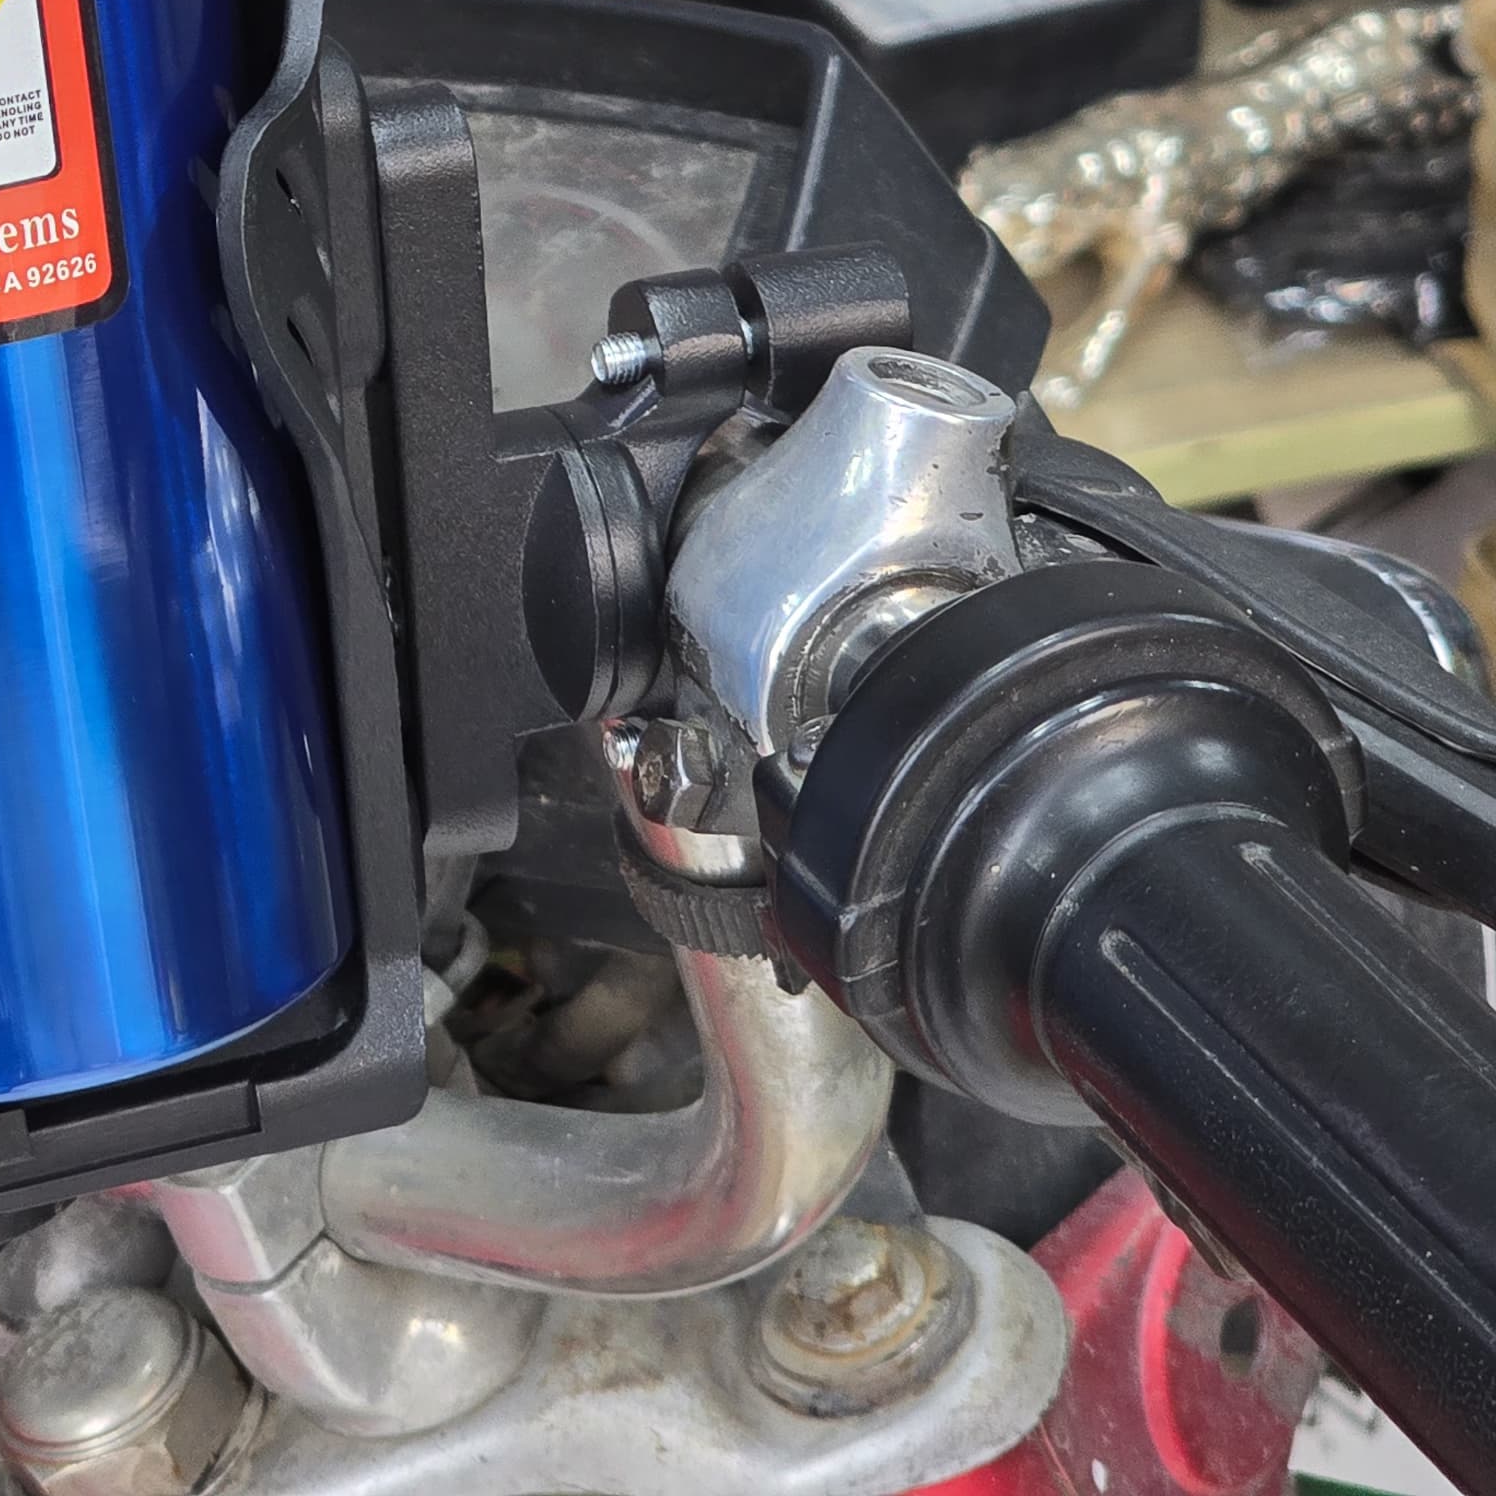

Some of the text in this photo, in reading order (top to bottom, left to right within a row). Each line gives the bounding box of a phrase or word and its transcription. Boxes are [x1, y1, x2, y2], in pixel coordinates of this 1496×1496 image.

[18, 112, 44, 125] TIME
[14, 125, 36, 139] NOT
[26, 252, 97, 288] 92626
